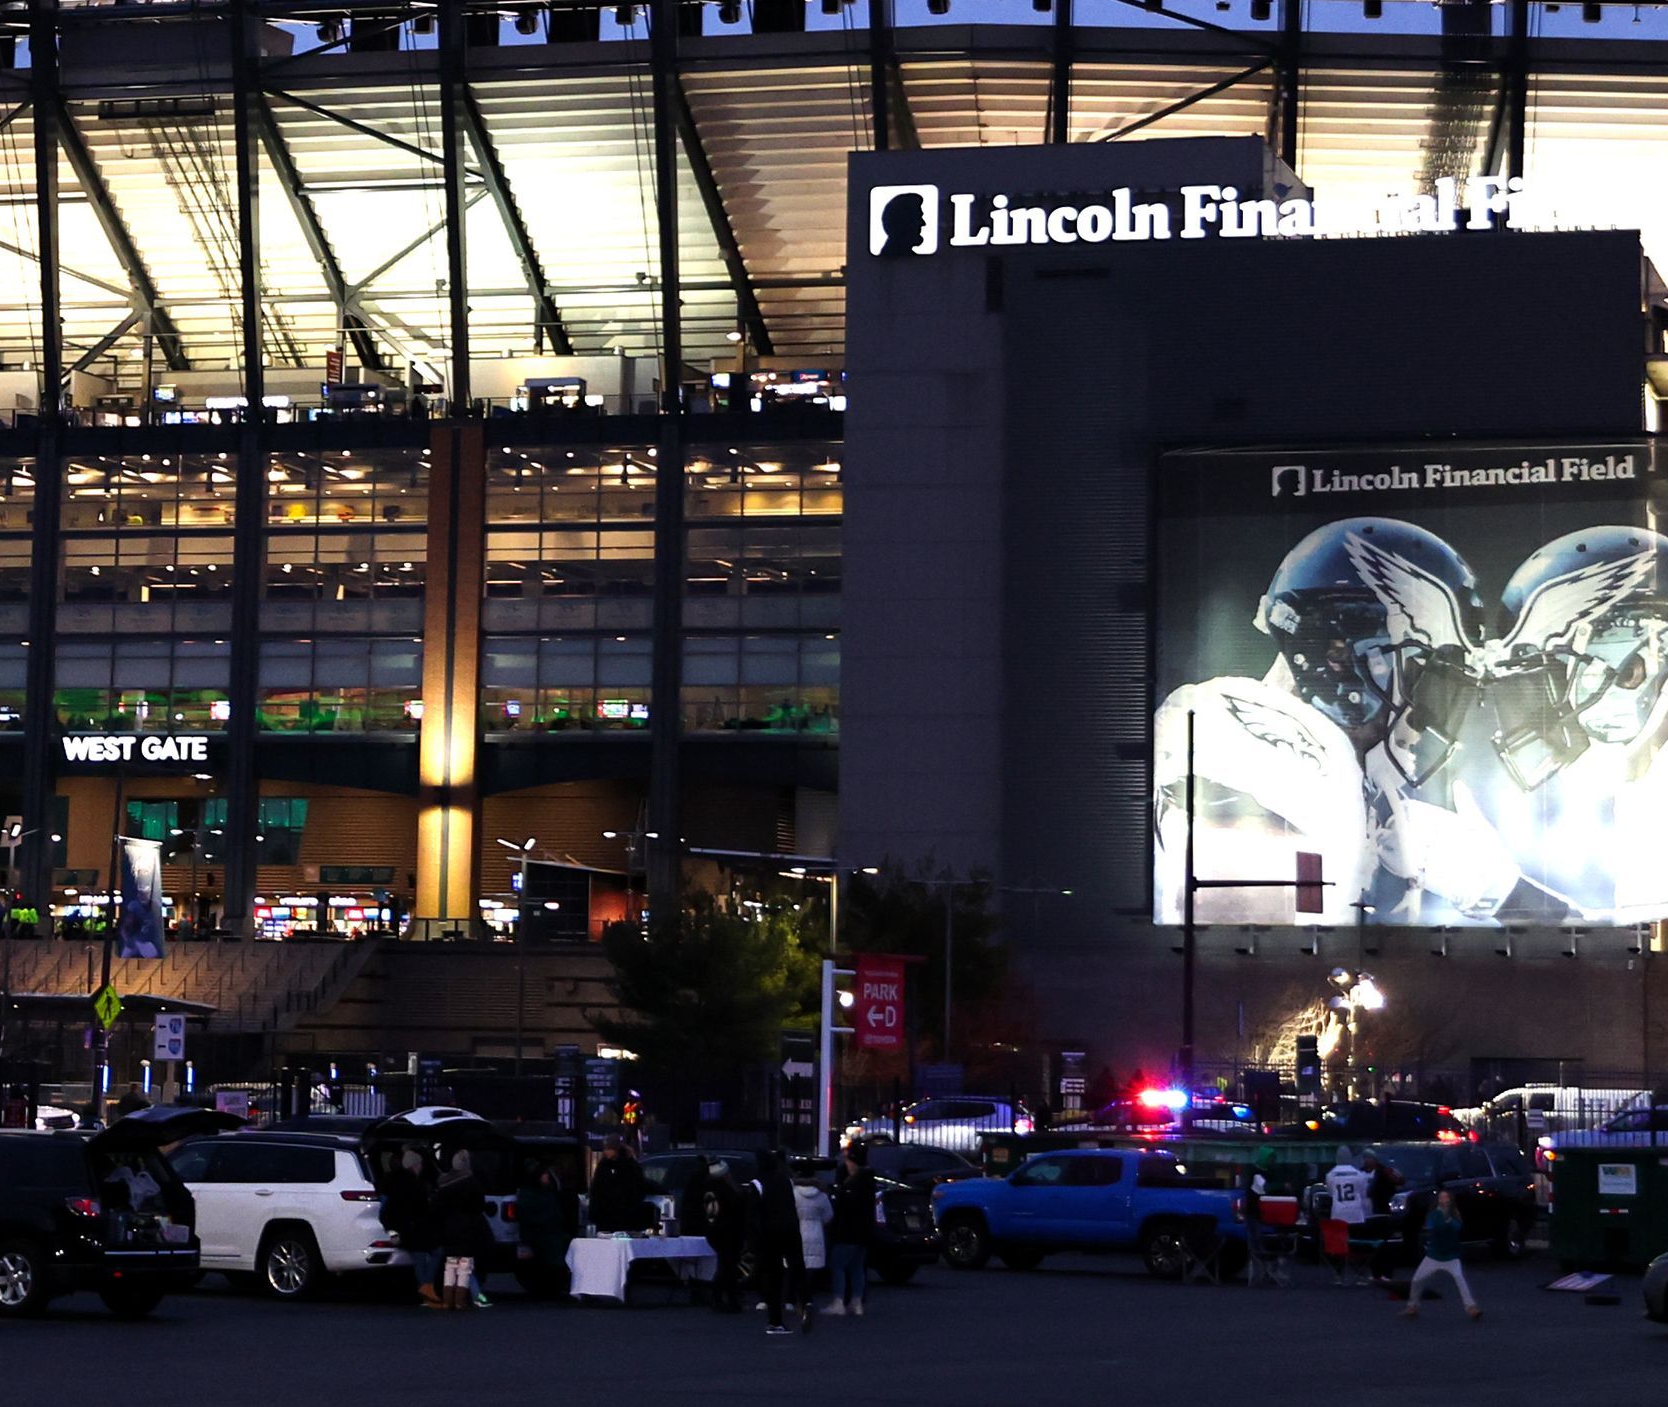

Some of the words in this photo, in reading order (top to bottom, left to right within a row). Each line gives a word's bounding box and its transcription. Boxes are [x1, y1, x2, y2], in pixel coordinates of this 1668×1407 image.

[950, 188, 1171, 247] Lincoln
[1180, 176, 1457, 239] Finaal
[1312, 465, 1419, 493] Lincoln
[1423, 459, 1556, 489] Financial
[1560, 455, 1635, 483] Field
[62, 736, 136, 762] WEST
[141, 736, 208, 762] GATE
[863, 982, 899, 1001] PARK
[885, 1005, 897, 1028] D
[1336, 1183, 1355, 1202] 12
